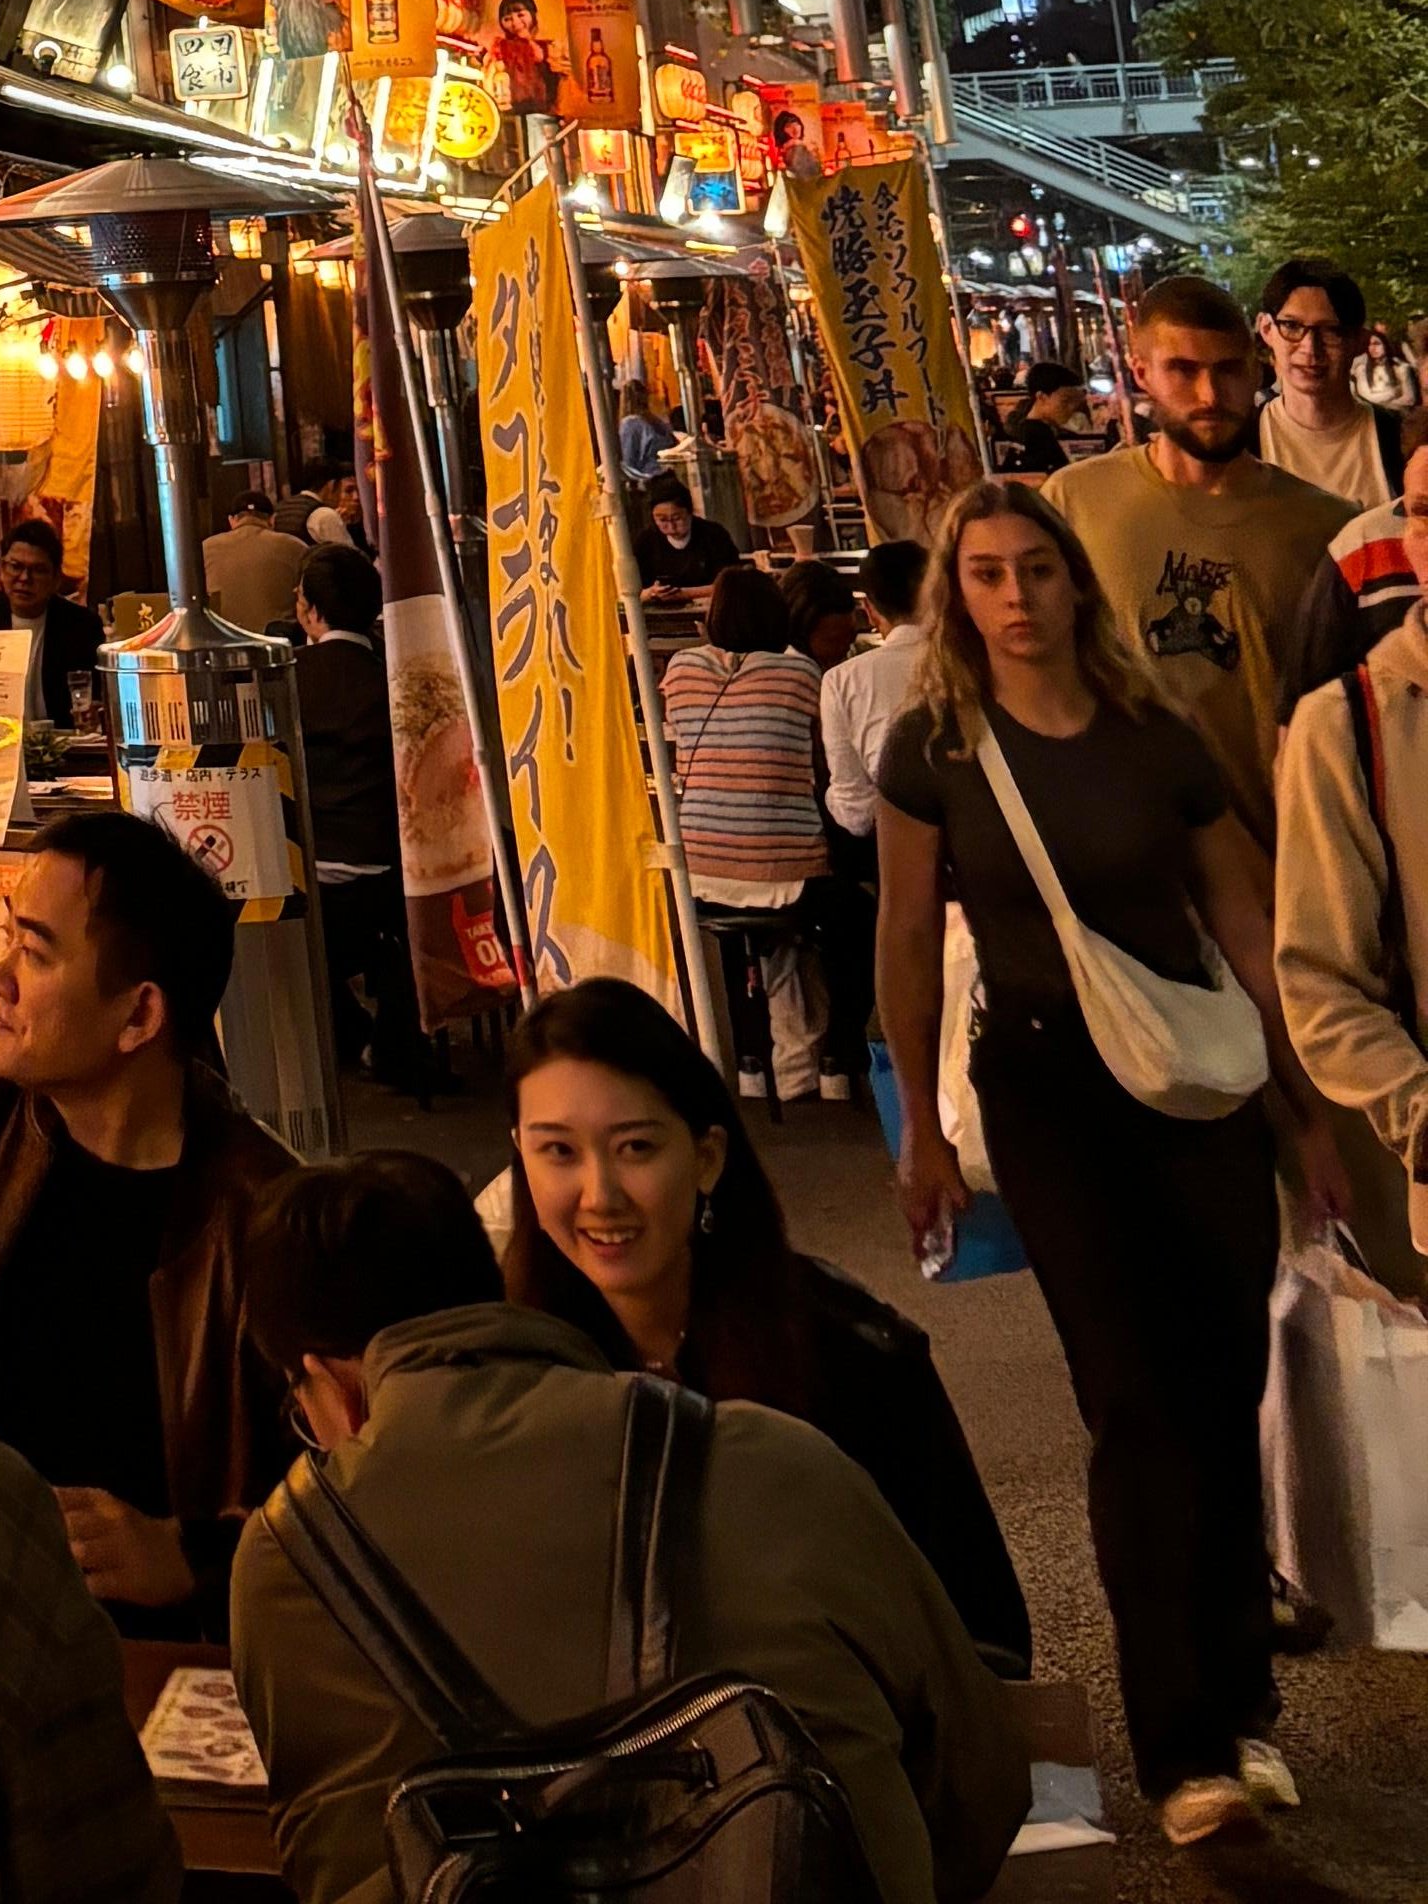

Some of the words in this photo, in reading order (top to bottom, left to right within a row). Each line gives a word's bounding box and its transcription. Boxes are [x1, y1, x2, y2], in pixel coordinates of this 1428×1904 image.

[172, 790, 234, 823] 禁煙
[489, 272, 572, 985] タコライス
